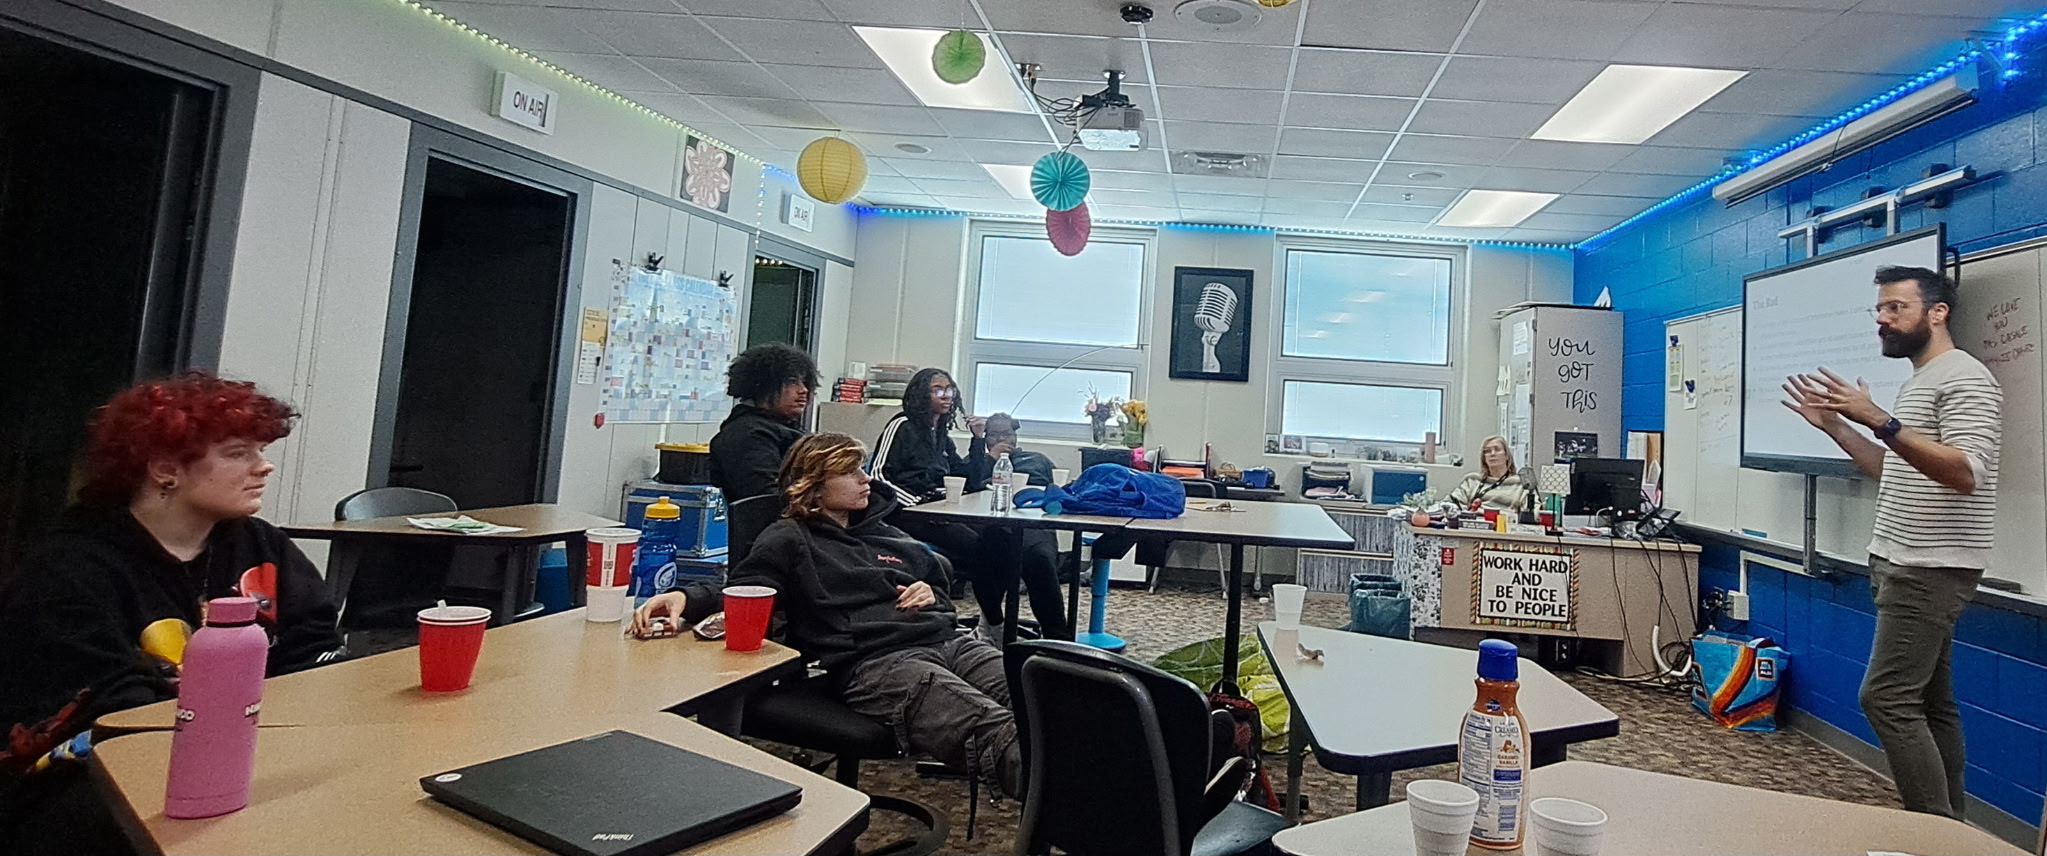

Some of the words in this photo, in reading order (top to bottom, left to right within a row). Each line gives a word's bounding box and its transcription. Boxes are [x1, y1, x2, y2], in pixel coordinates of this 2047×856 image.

[513, 91, 528, 111] ON
[528, 98, 544, 119] AIR
[1483, 556, 1523, 572] WORK
[1529, 558, 1568, 573] HARD
[1512, 572, 1542, 586] AND
[1495, 585, 1513, 599] BE
[1521, 587, 1557, 602] NICE
[1488, 599, 1507, 613] TO
[1515, 602, 1567, 617] PEOPLE
